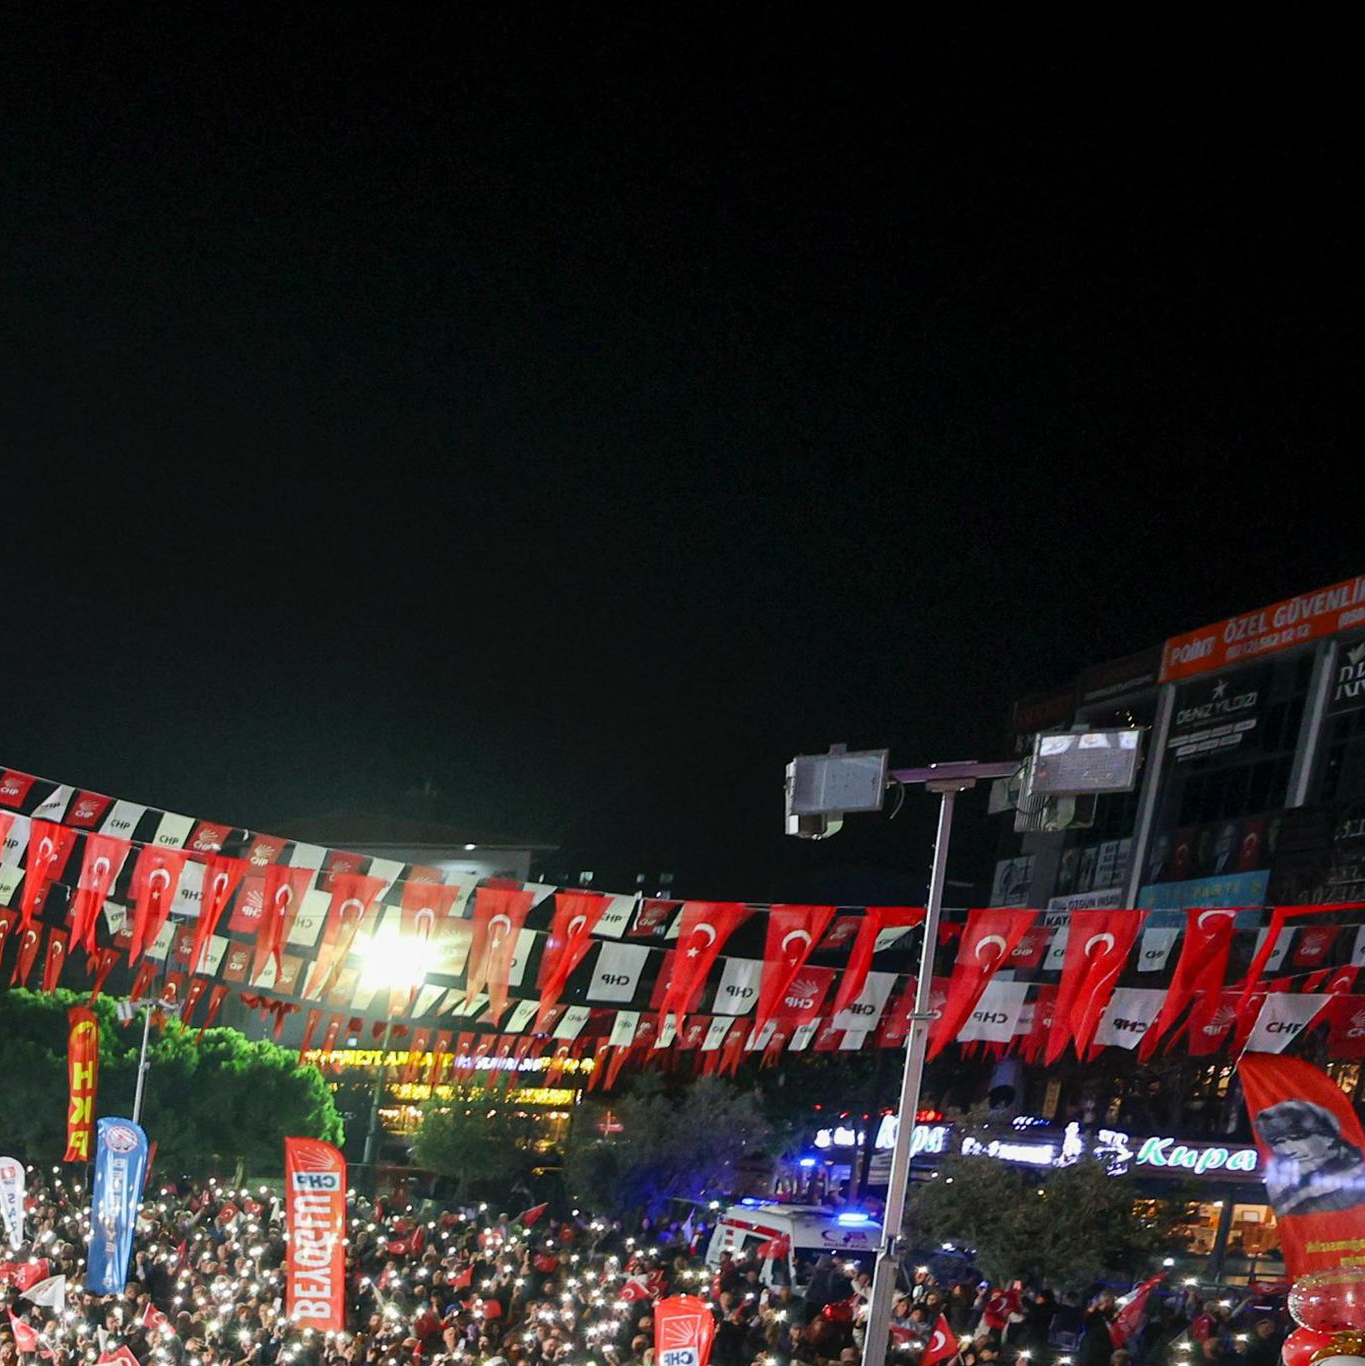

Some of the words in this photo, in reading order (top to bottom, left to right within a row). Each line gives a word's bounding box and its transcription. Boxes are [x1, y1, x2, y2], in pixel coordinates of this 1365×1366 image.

[1273, 575, 1365, 628] GÜVENLİ
[0, 786, 19, 796] CHP
[76, 809, 94, 819] CHP
[111, 820, 130, 830] CHP
[159, 835, 179, 845] CHP
[1011, 946, 1033, 957] CHP
